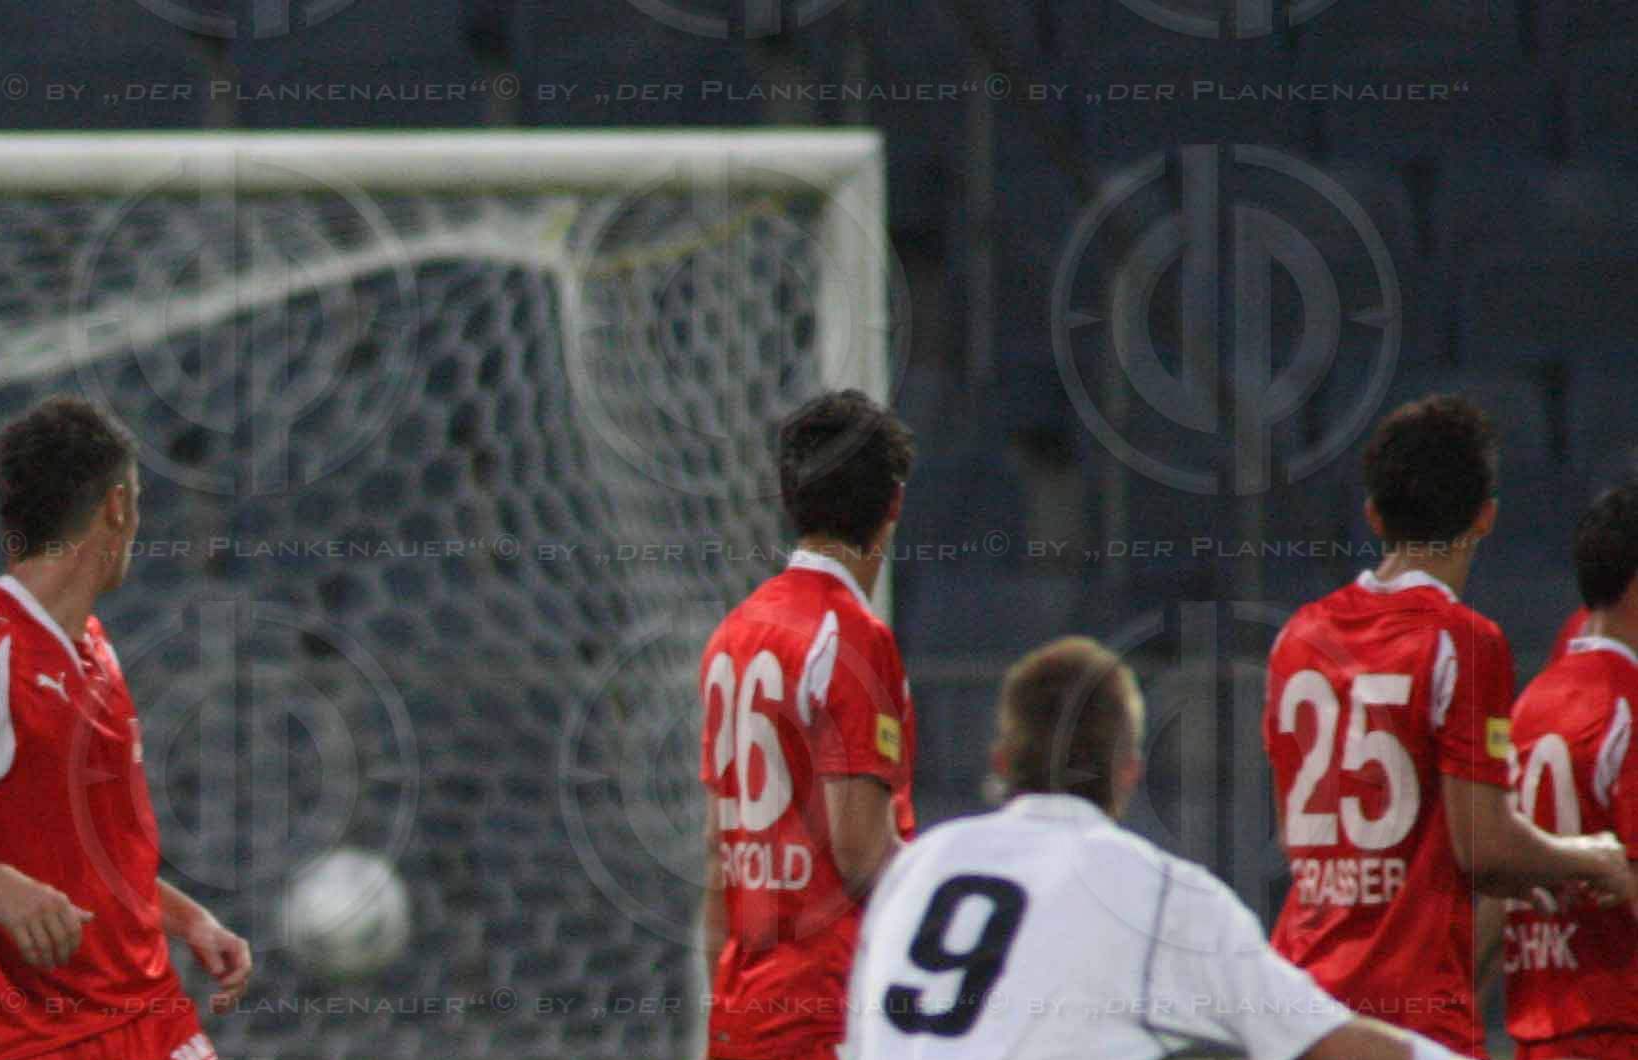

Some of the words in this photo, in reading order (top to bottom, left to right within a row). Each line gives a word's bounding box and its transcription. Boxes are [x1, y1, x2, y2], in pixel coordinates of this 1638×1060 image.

[704, 650, 794, 833] 26
[1279, 669, 1421, 850] 25
[882, 873, 1029, 1038] 9
